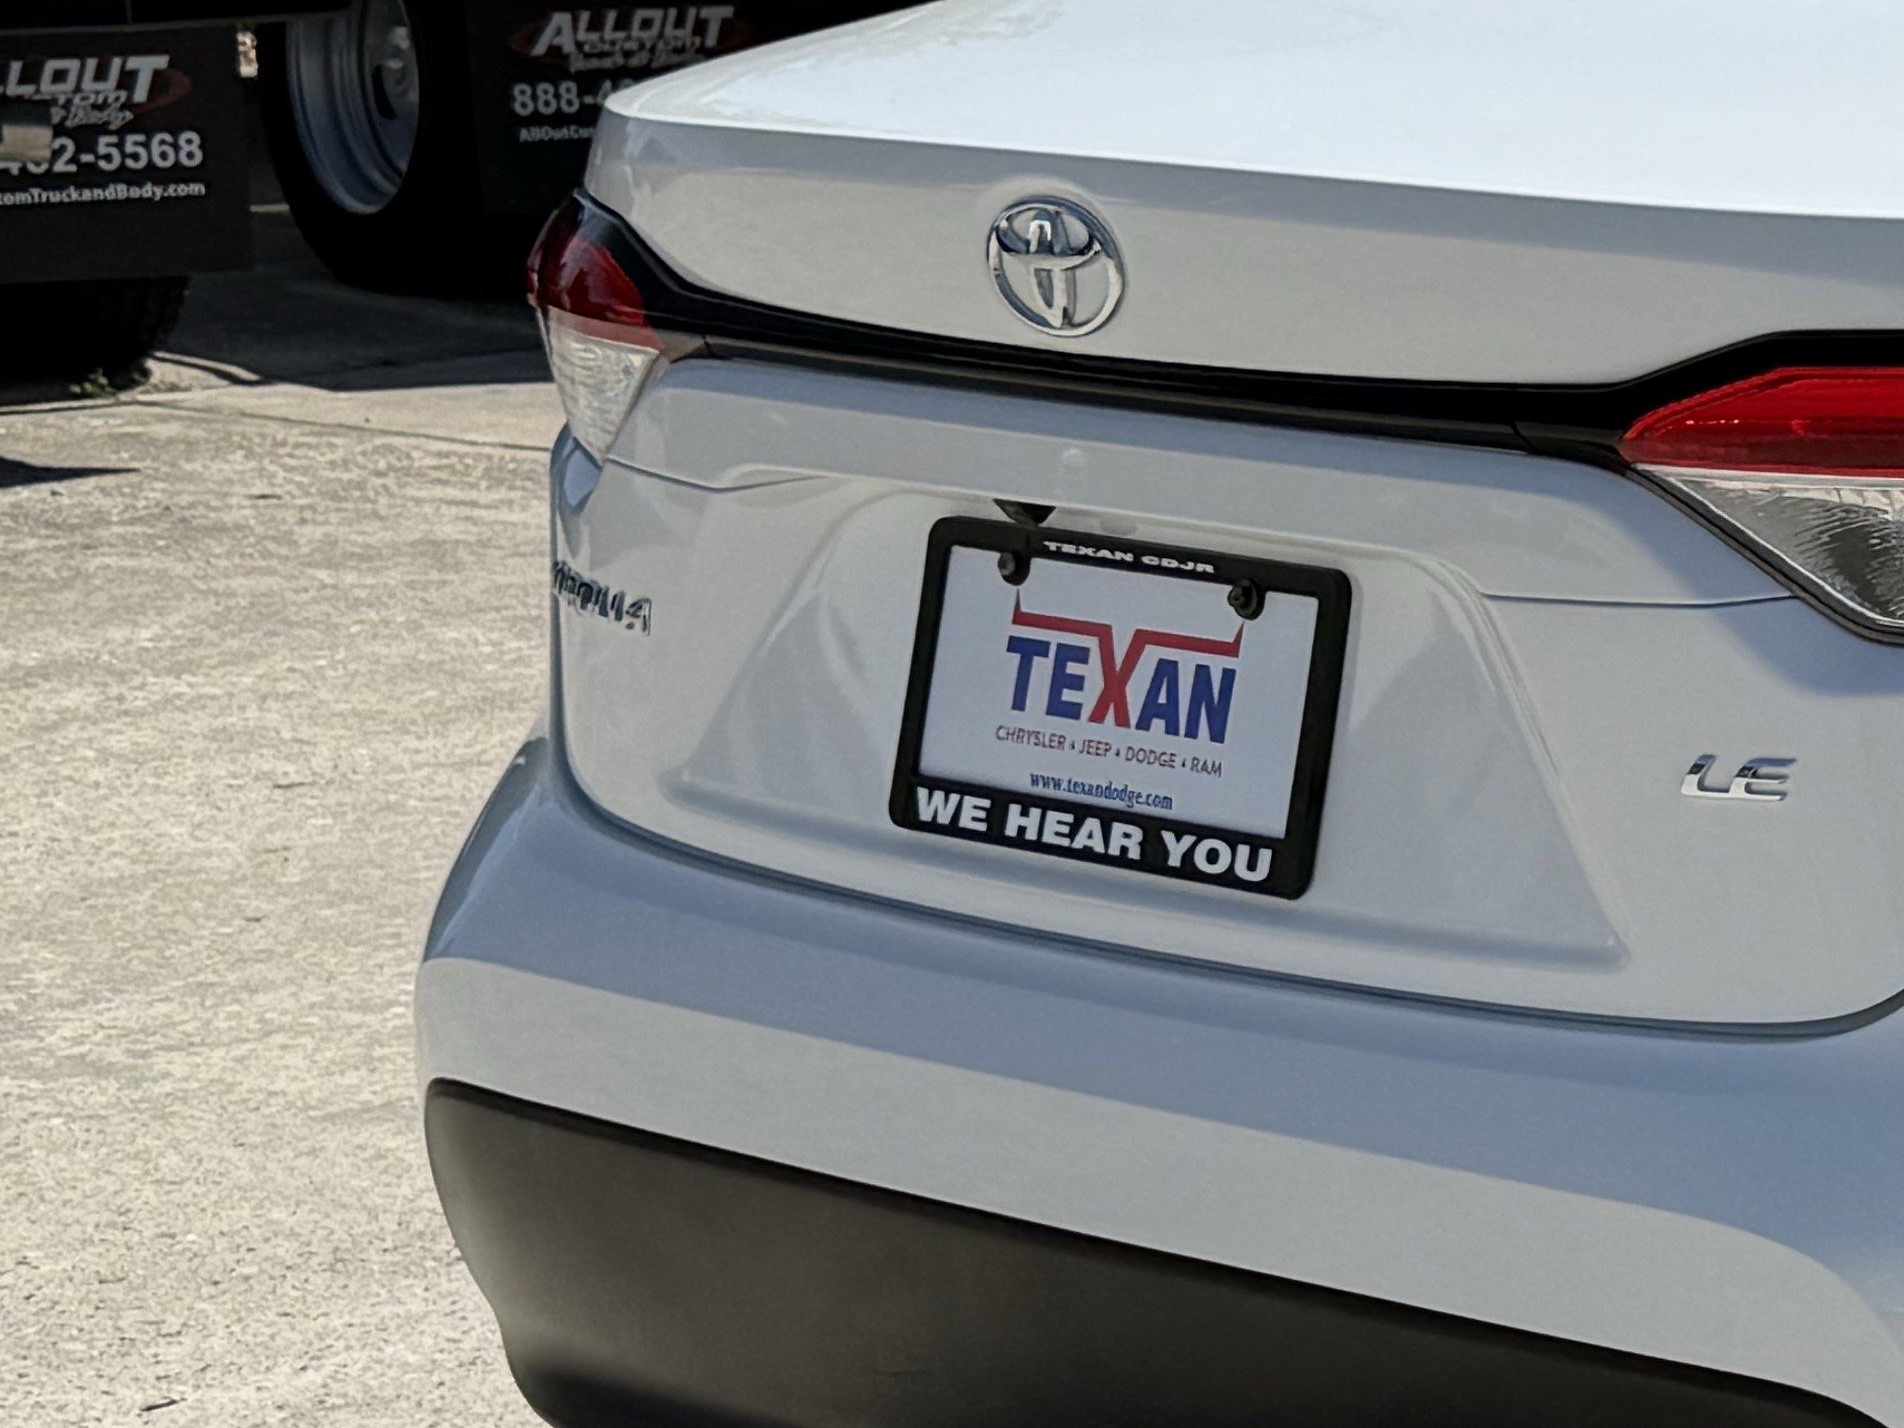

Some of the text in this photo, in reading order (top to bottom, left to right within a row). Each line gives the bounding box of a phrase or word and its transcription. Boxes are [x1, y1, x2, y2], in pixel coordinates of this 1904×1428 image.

[530, 5, 735, 57] ALLOUT
[1043, 540, 1215, 574] TEXAN CDJR
[1006, 620, 1238, 745] TEXAN
[995, 725, 1223, 778] CHRYSLER JEEP DODGE RAM
[1680, 753, 1798, 802] LE
[1029, 771, 1174, 811] www.texandodge.com
[915, 786, 1273, 882] WE HEAR YOU
